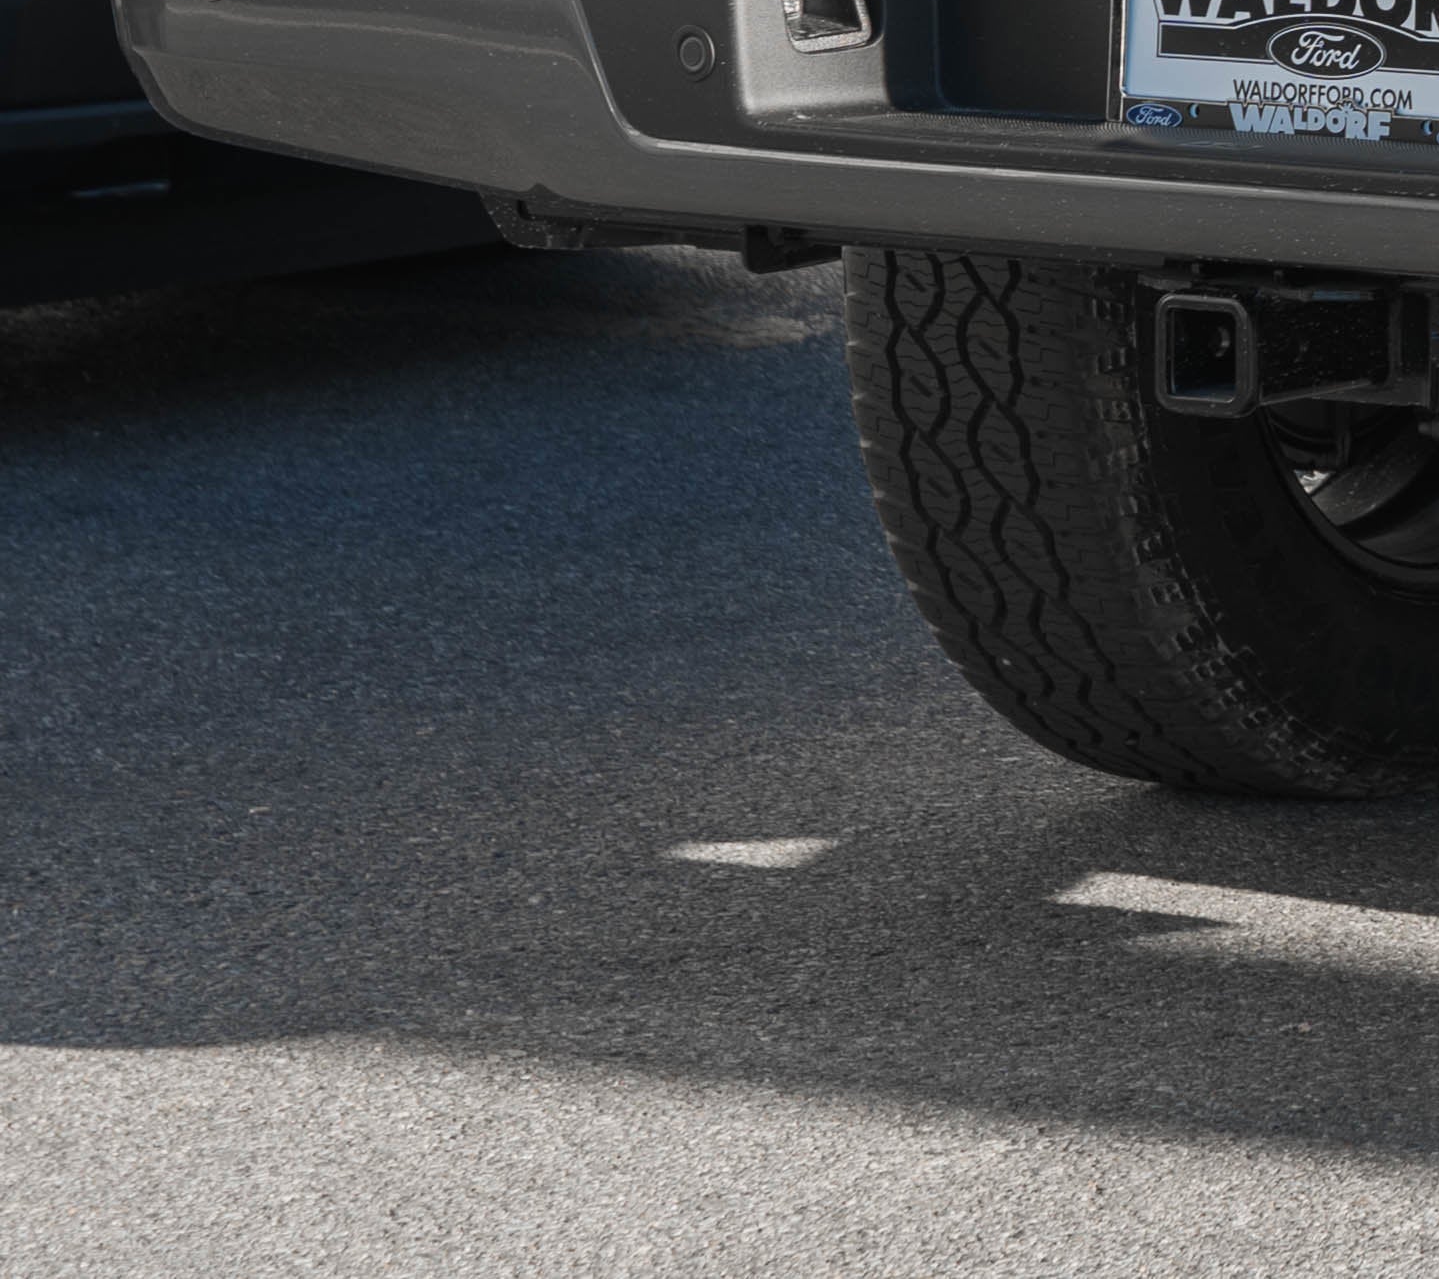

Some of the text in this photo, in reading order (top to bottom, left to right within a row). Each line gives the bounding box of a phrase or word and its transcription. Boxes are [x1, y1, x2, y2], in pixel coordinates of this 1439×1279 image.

[1290, 28, 1363, 73] Ford
[1232, 78, 1414, 111] WALDORFFORD.COM
[1133, 106, 1173, 127] Ford
[1231, 100, 1393, 141] WALDORF
